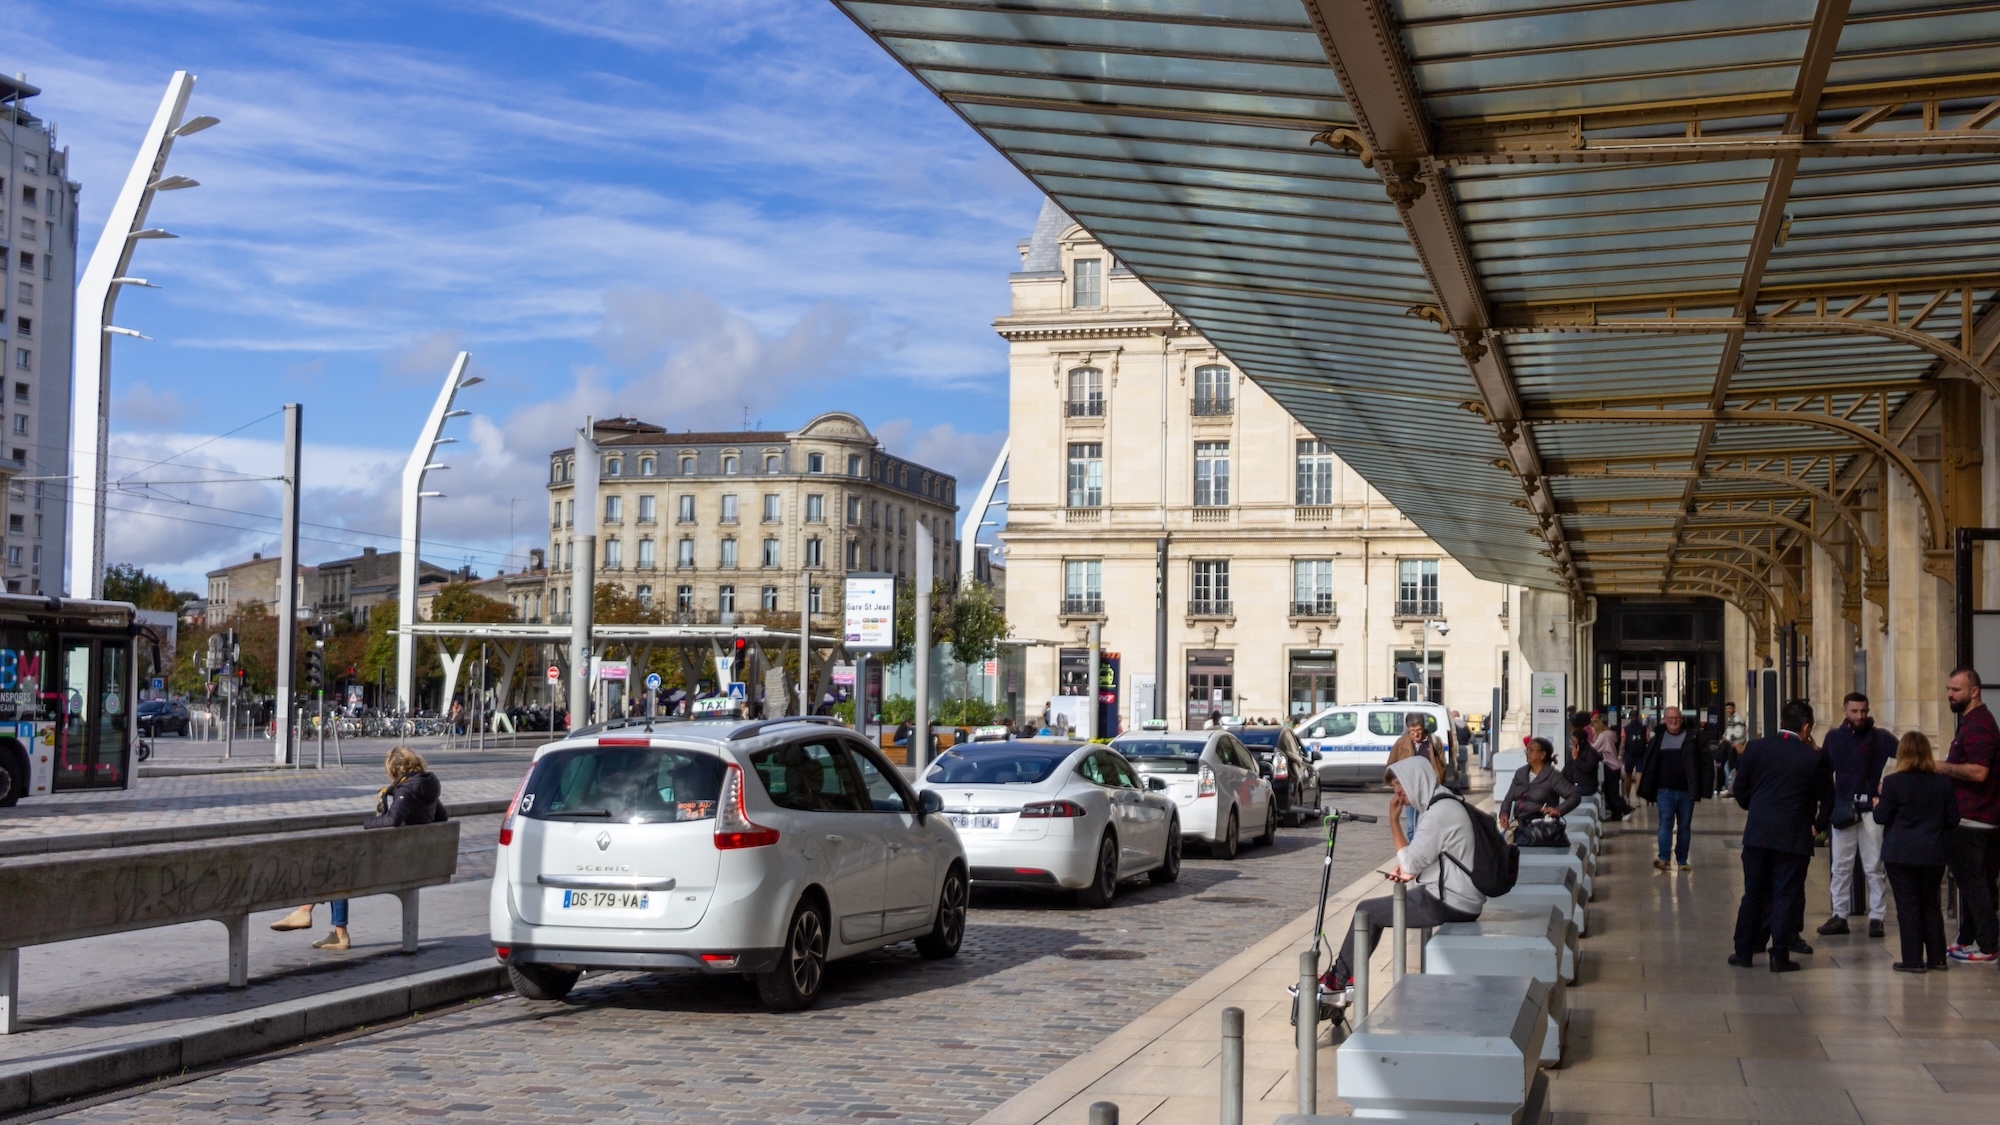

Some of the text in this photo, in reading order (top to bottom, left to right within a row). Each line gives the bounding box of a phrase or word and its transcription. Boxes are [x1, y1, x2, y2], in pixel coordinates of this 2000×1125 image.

[846, 602, 891, 611] Gare St Jean
[700, 699, 727, 710] TAXI
[576, 864, 630, 872] SCENIC
[571, 892, 639, 908] DS-179-VA
